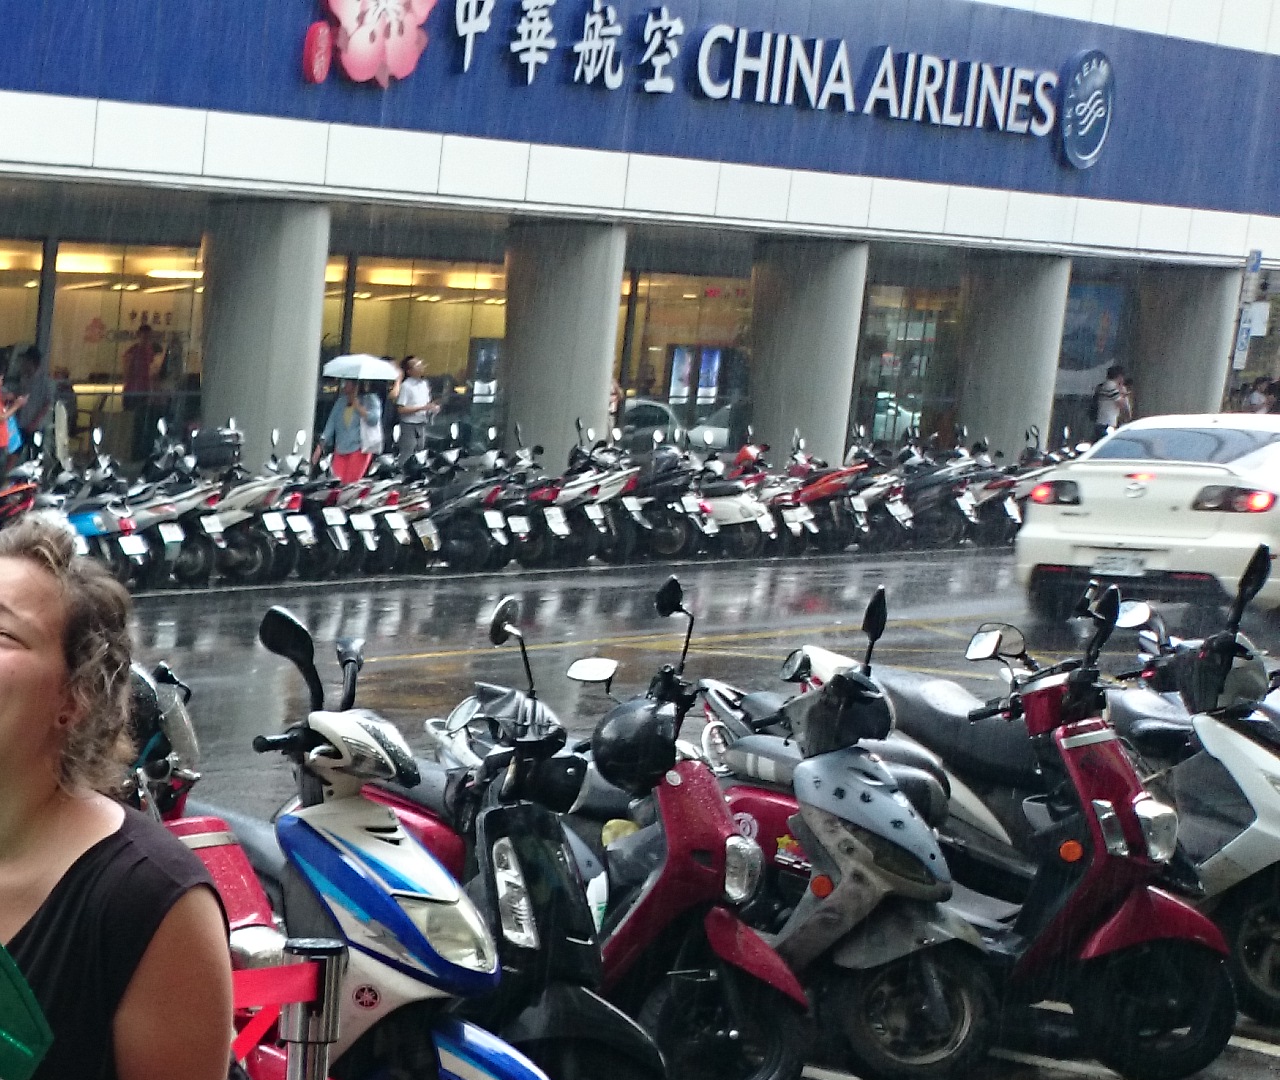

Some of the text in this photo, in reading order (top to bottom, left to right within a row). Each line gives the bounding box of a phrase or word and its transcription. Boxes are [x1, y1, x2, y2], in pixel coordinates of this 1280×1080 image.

[455, 0, 684, 93] 中華航空
[696, 23, 1059, 137] CHINA AIRLINES
